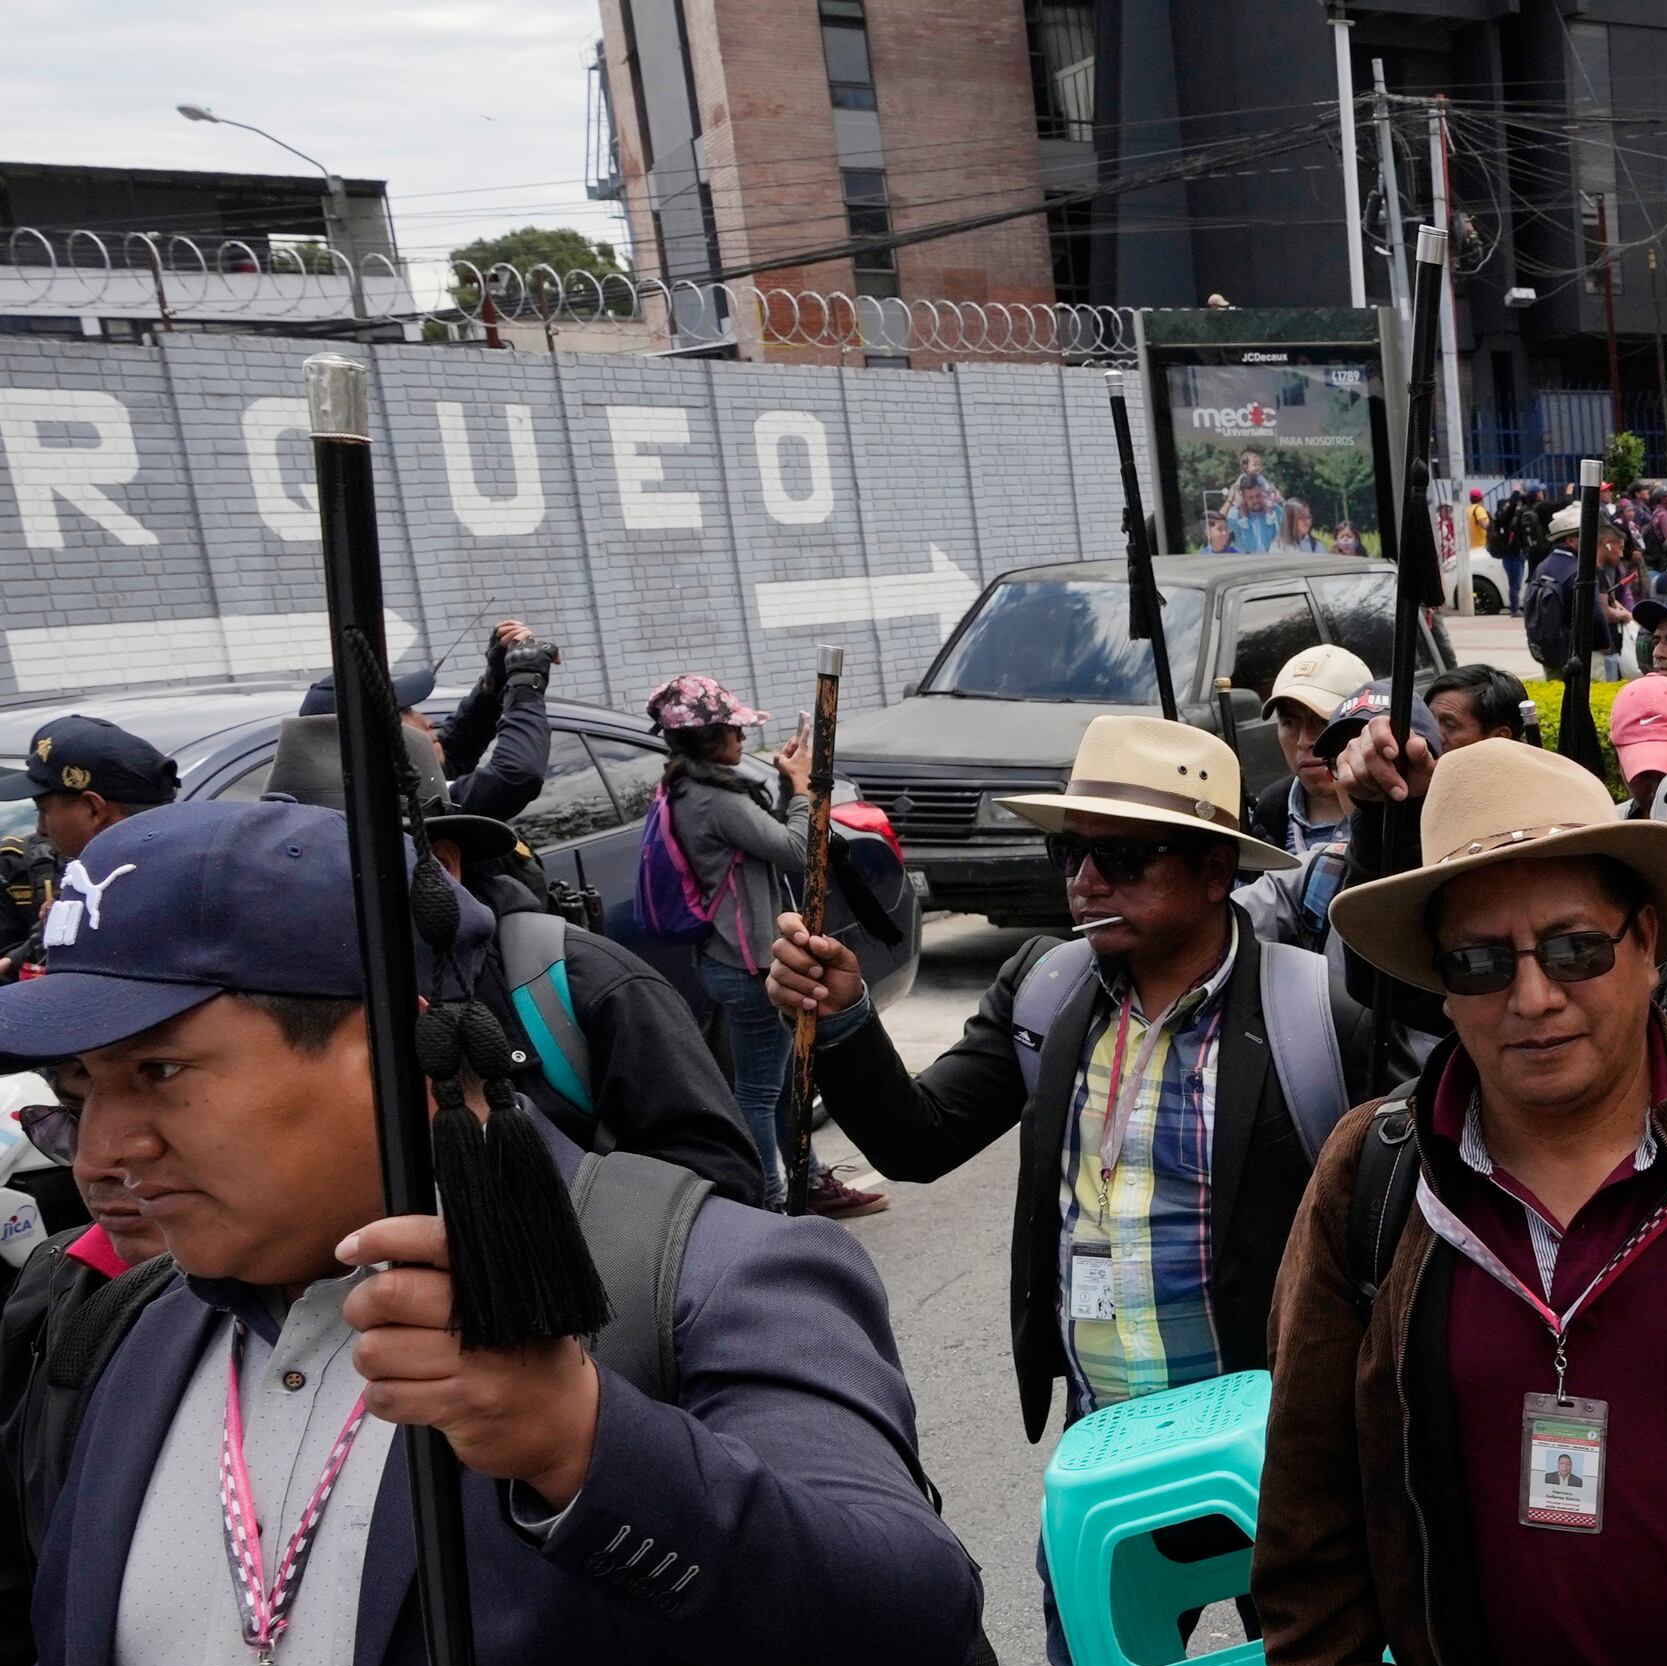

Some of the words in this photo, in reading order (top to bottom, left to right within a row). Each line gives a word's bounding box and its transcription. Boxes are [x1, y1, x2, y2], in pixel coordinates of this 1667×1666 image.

[1242, 353, 1288, 363] JCDecaux
[1280, 436, 1303, 446] PARA
[1305, 435, 1354, 447] NOSOTROS
[1340, 694, 1390, 715] JORDAN
